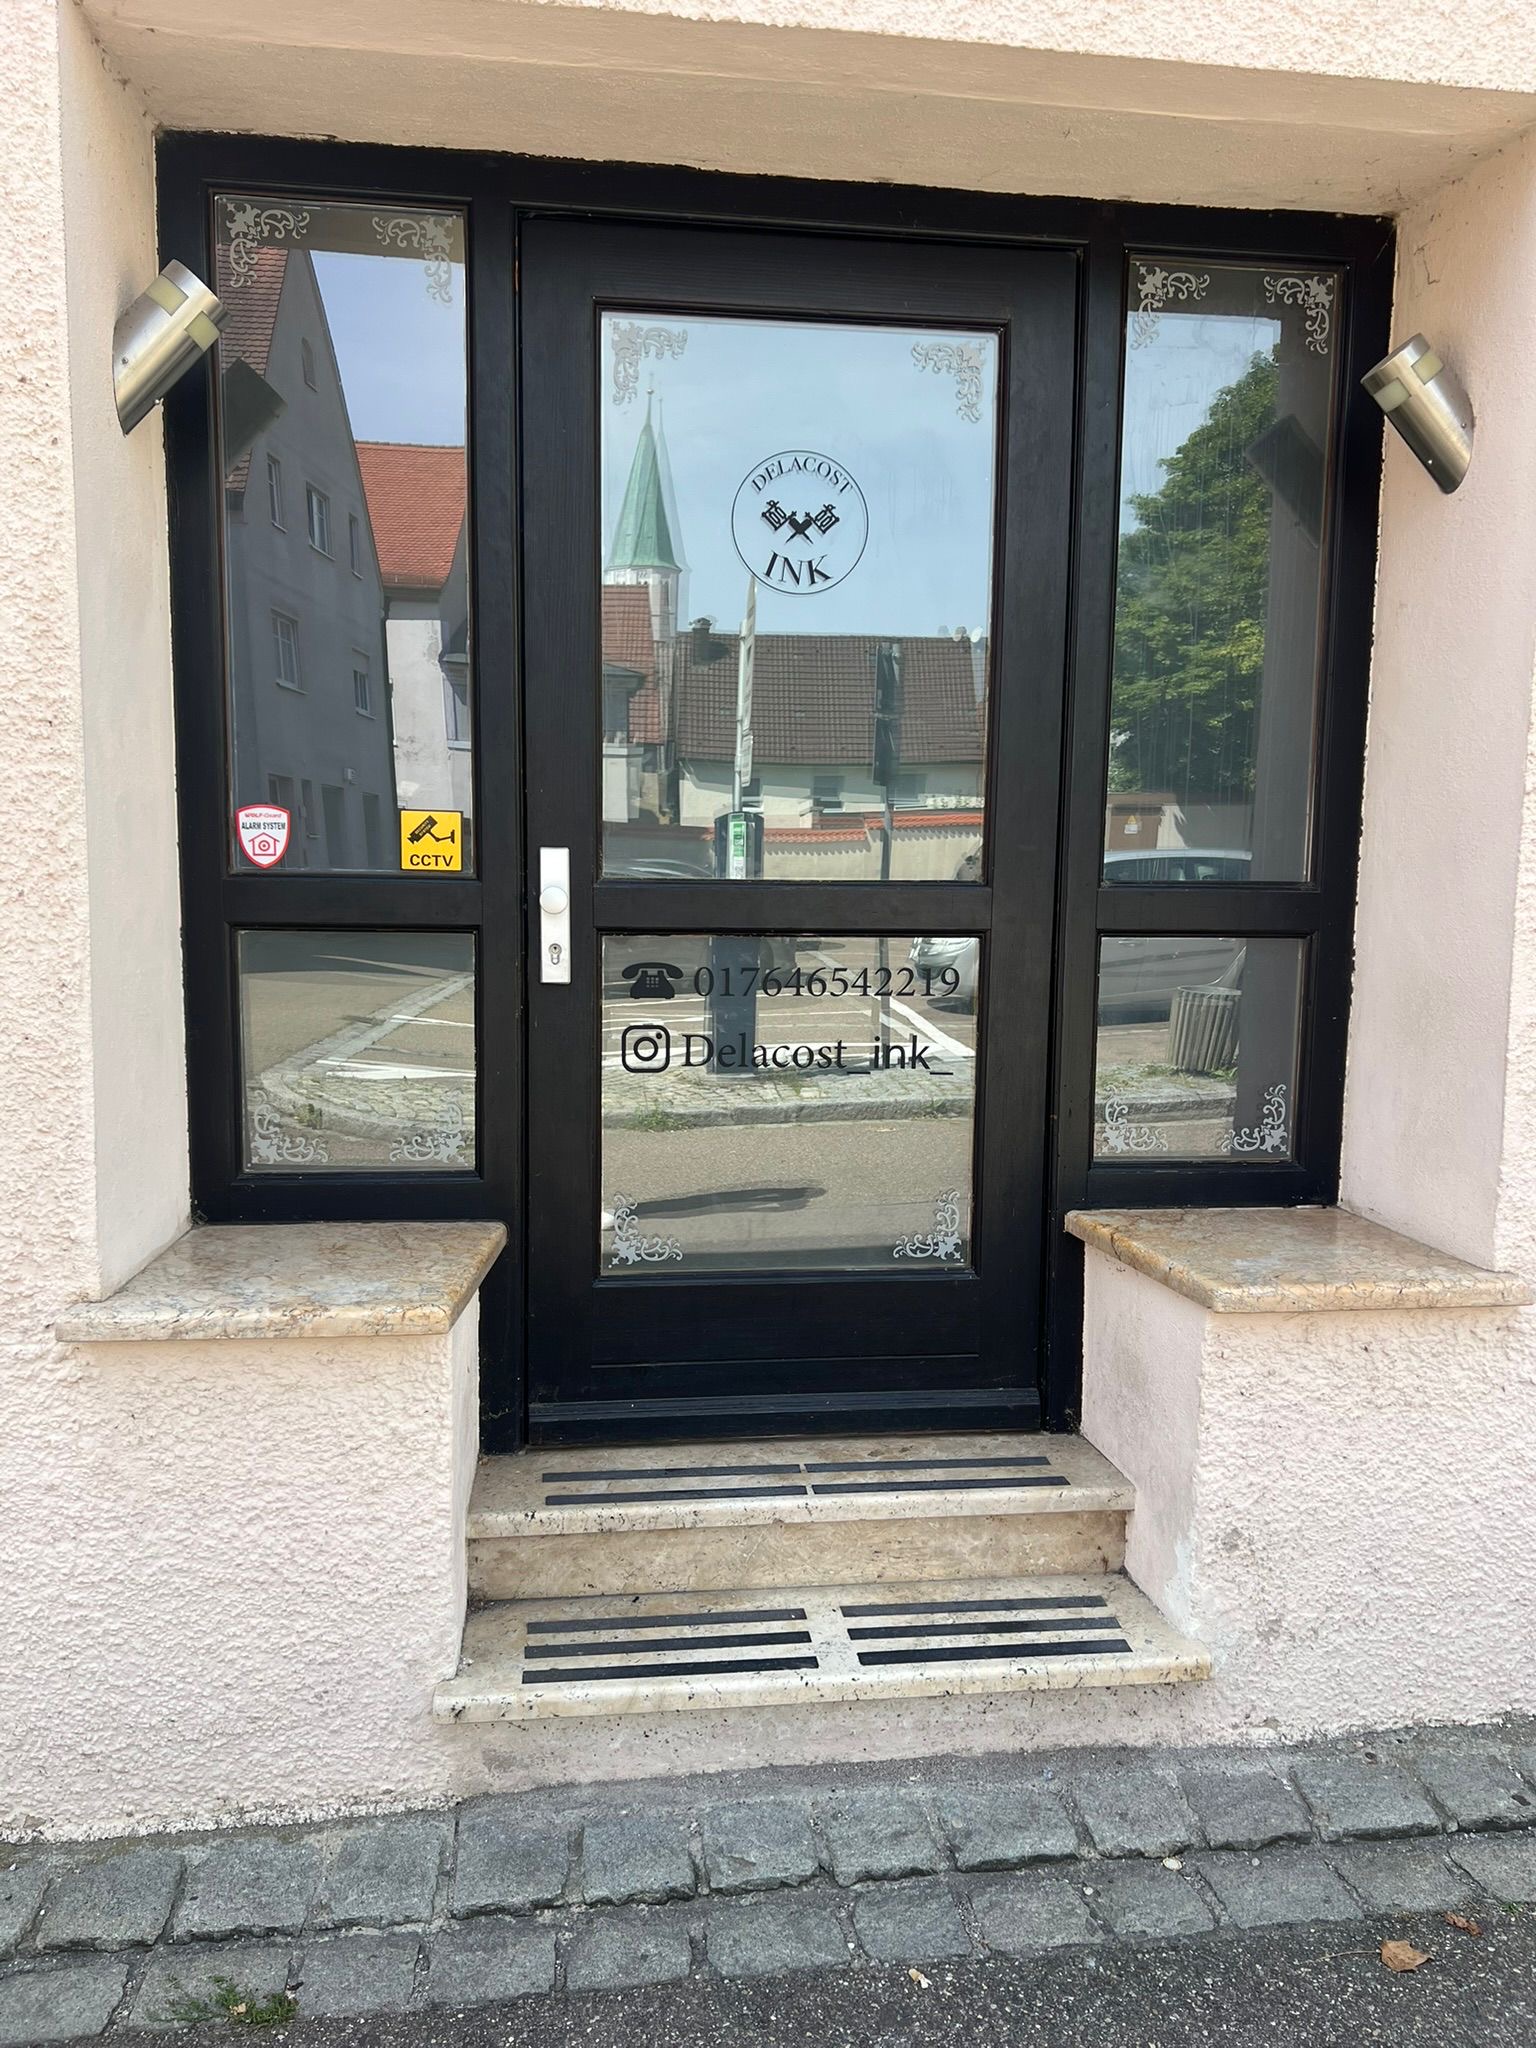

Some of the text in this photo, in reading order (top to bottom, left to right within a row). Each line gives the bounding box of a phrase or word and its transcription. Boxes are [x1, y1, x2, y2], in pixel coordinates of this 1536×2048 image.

[751, 456, 853, 494] DELACOST
[763, 550, 833, 586] INK
[241, 821, 286, 830] ALARM SYSTEM
[409, 854, 453, 867] CCTV
[693, 966, 961, 998] 017646542219
[681, 1032, 954, 1076] Delacost_ink_
